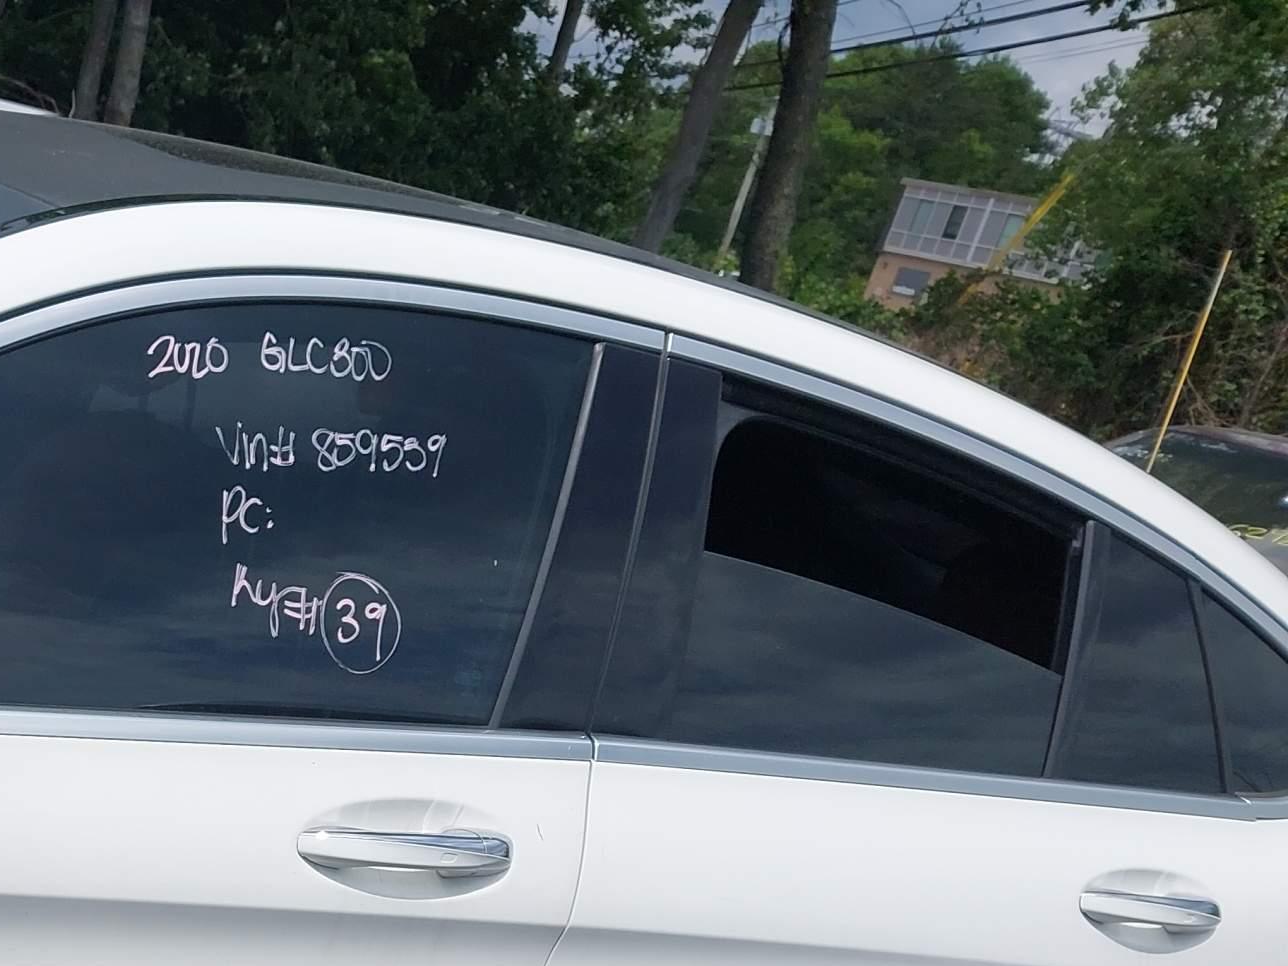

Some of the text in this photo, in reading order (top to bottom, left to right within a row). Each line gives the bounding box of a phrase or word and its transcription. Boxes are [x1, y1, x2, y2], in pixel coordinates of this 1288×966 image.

[262, 332, 391, 380] GLC300
[312, 428, 446, 477] 859539
[336, 599, 387, 661] 39
